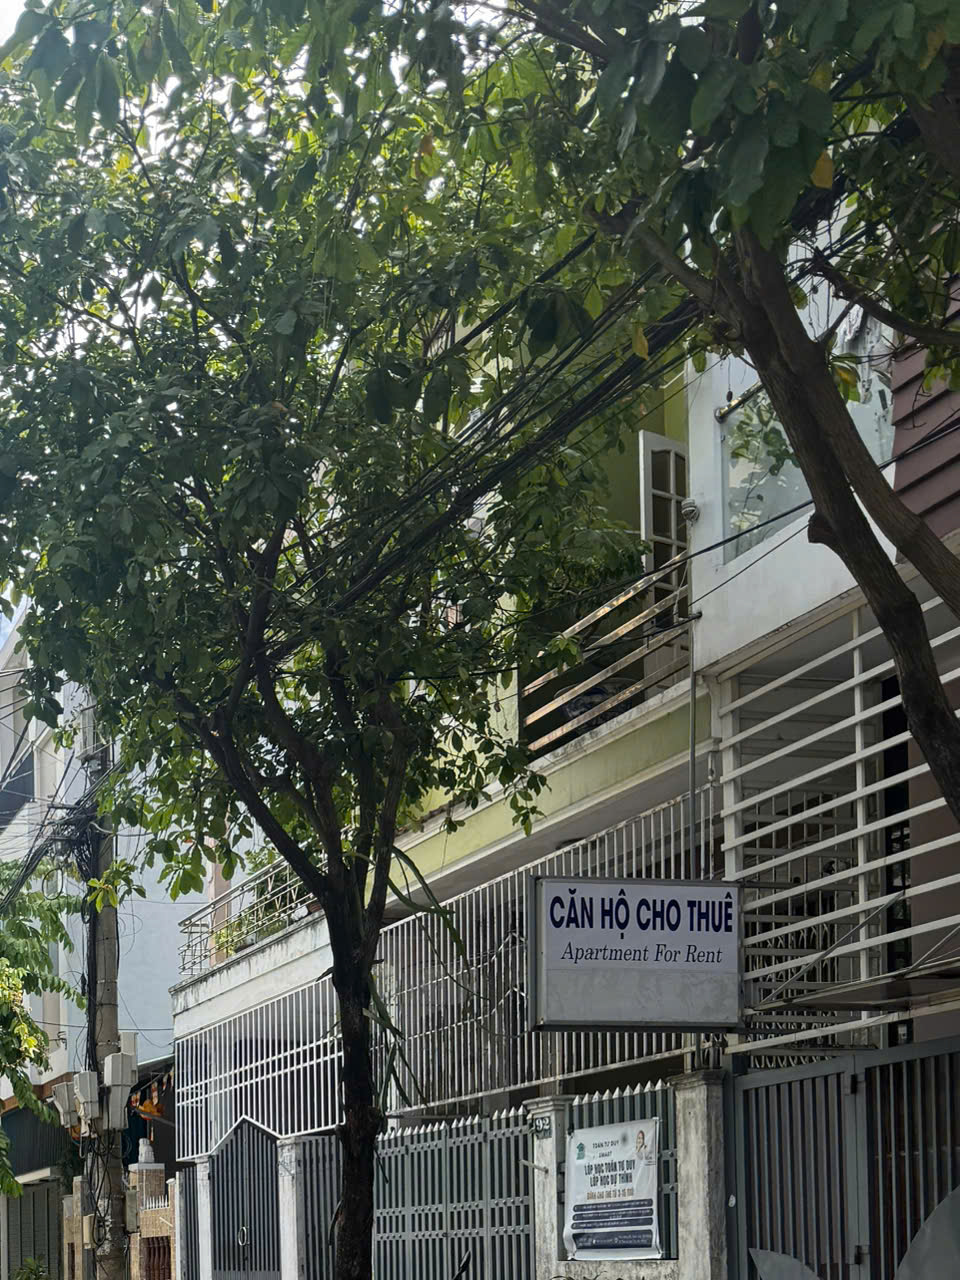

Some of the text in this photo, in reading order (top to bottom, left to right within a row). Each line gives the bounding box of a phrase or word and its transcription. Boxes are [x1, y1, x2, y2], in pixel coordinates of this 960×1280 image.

[550, 888, 733, 940] CĂN HỘ CHO THUÊ
[561, 942, 723, 964] Apartment For Rent
[536, 1117, 550, 1131] 92
